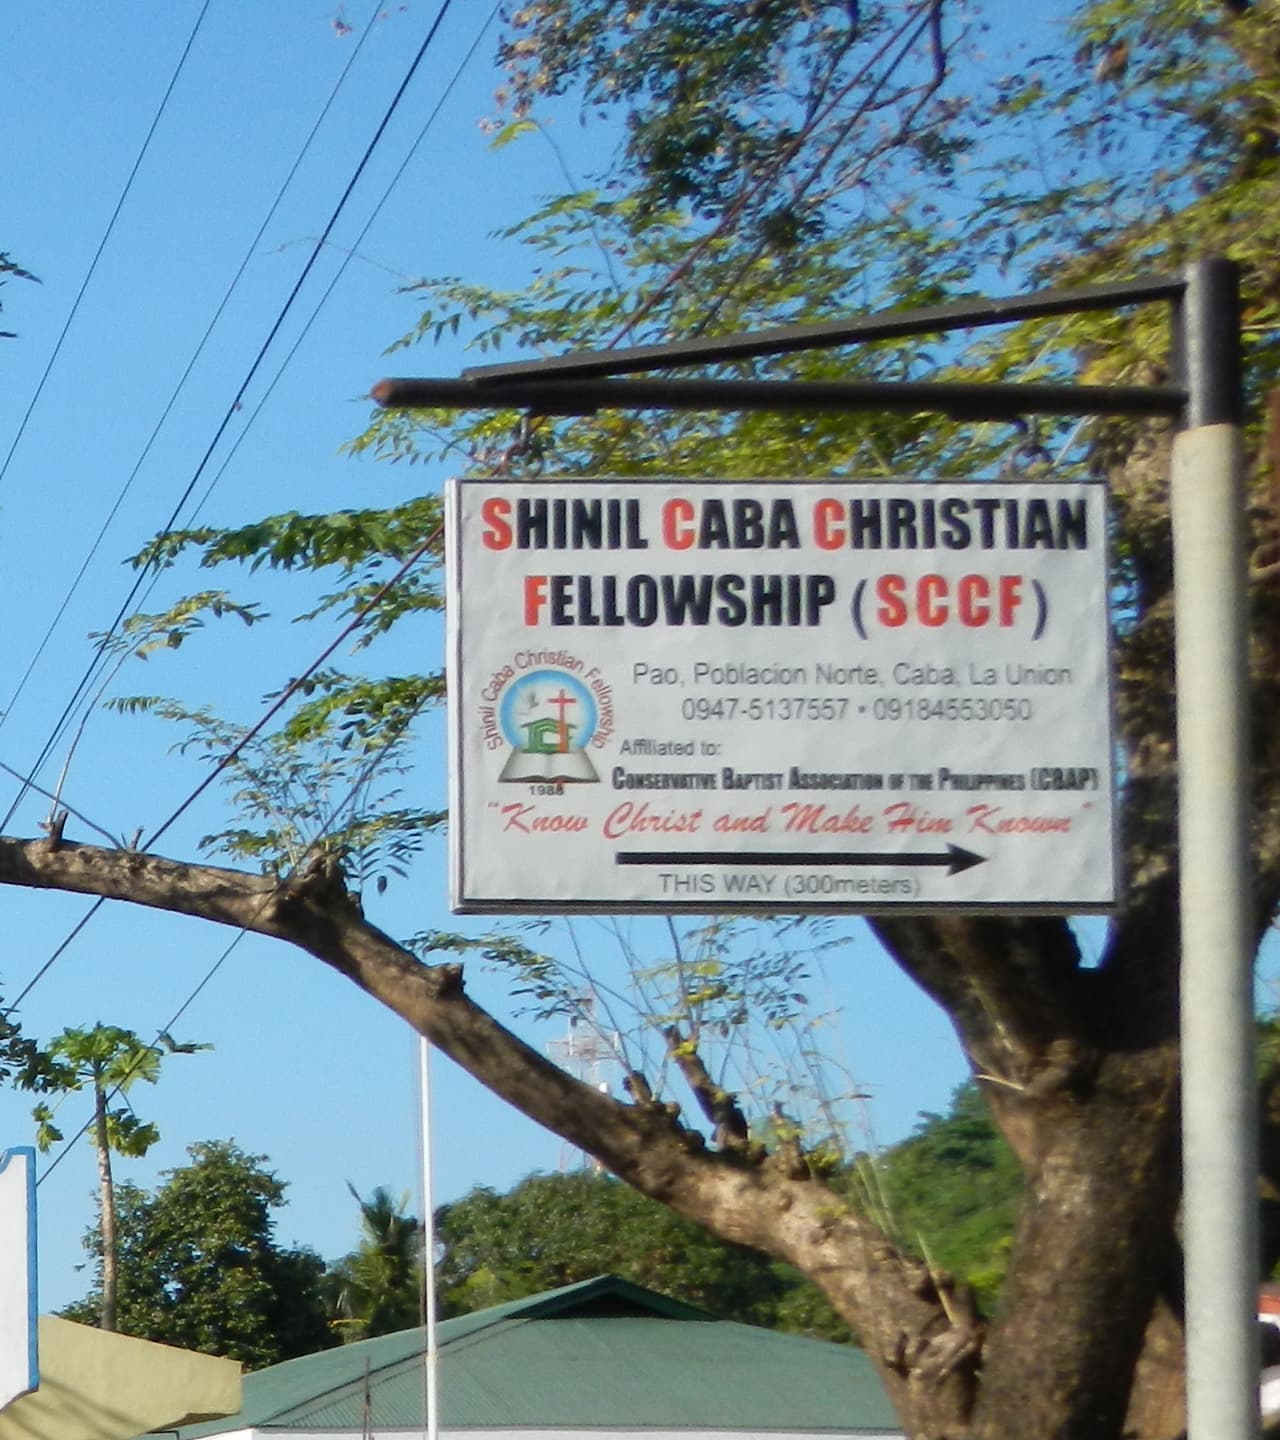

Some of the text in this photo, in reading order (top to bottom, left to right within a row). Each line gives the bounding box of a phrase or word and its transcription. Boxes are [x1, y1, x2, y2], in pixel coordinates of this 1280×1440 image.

[482, 497, 1088, 552] SHINIL CABA CHRISTIAN
[523, 573, 1048, 640] FELLOWSHIP (SCCF)
[633, 662, 1072, 688] Pao, Poblacion Norte, Caba, La Union
[478, 648, 616, 751] Shinil Caba Christian Fellowship
[682, 698, 1033, 720] 0947-5137557 09184553050
[620, 738, 722, 756] Affiliated to:
[603, 801, 704, 839] Christ
[712, 807, 771, 833] and
[781, 802, 875, 834] Make
[883, 802, 953, 834] Him
[658, 873, 922, 896] THIS WAY (300meters)
